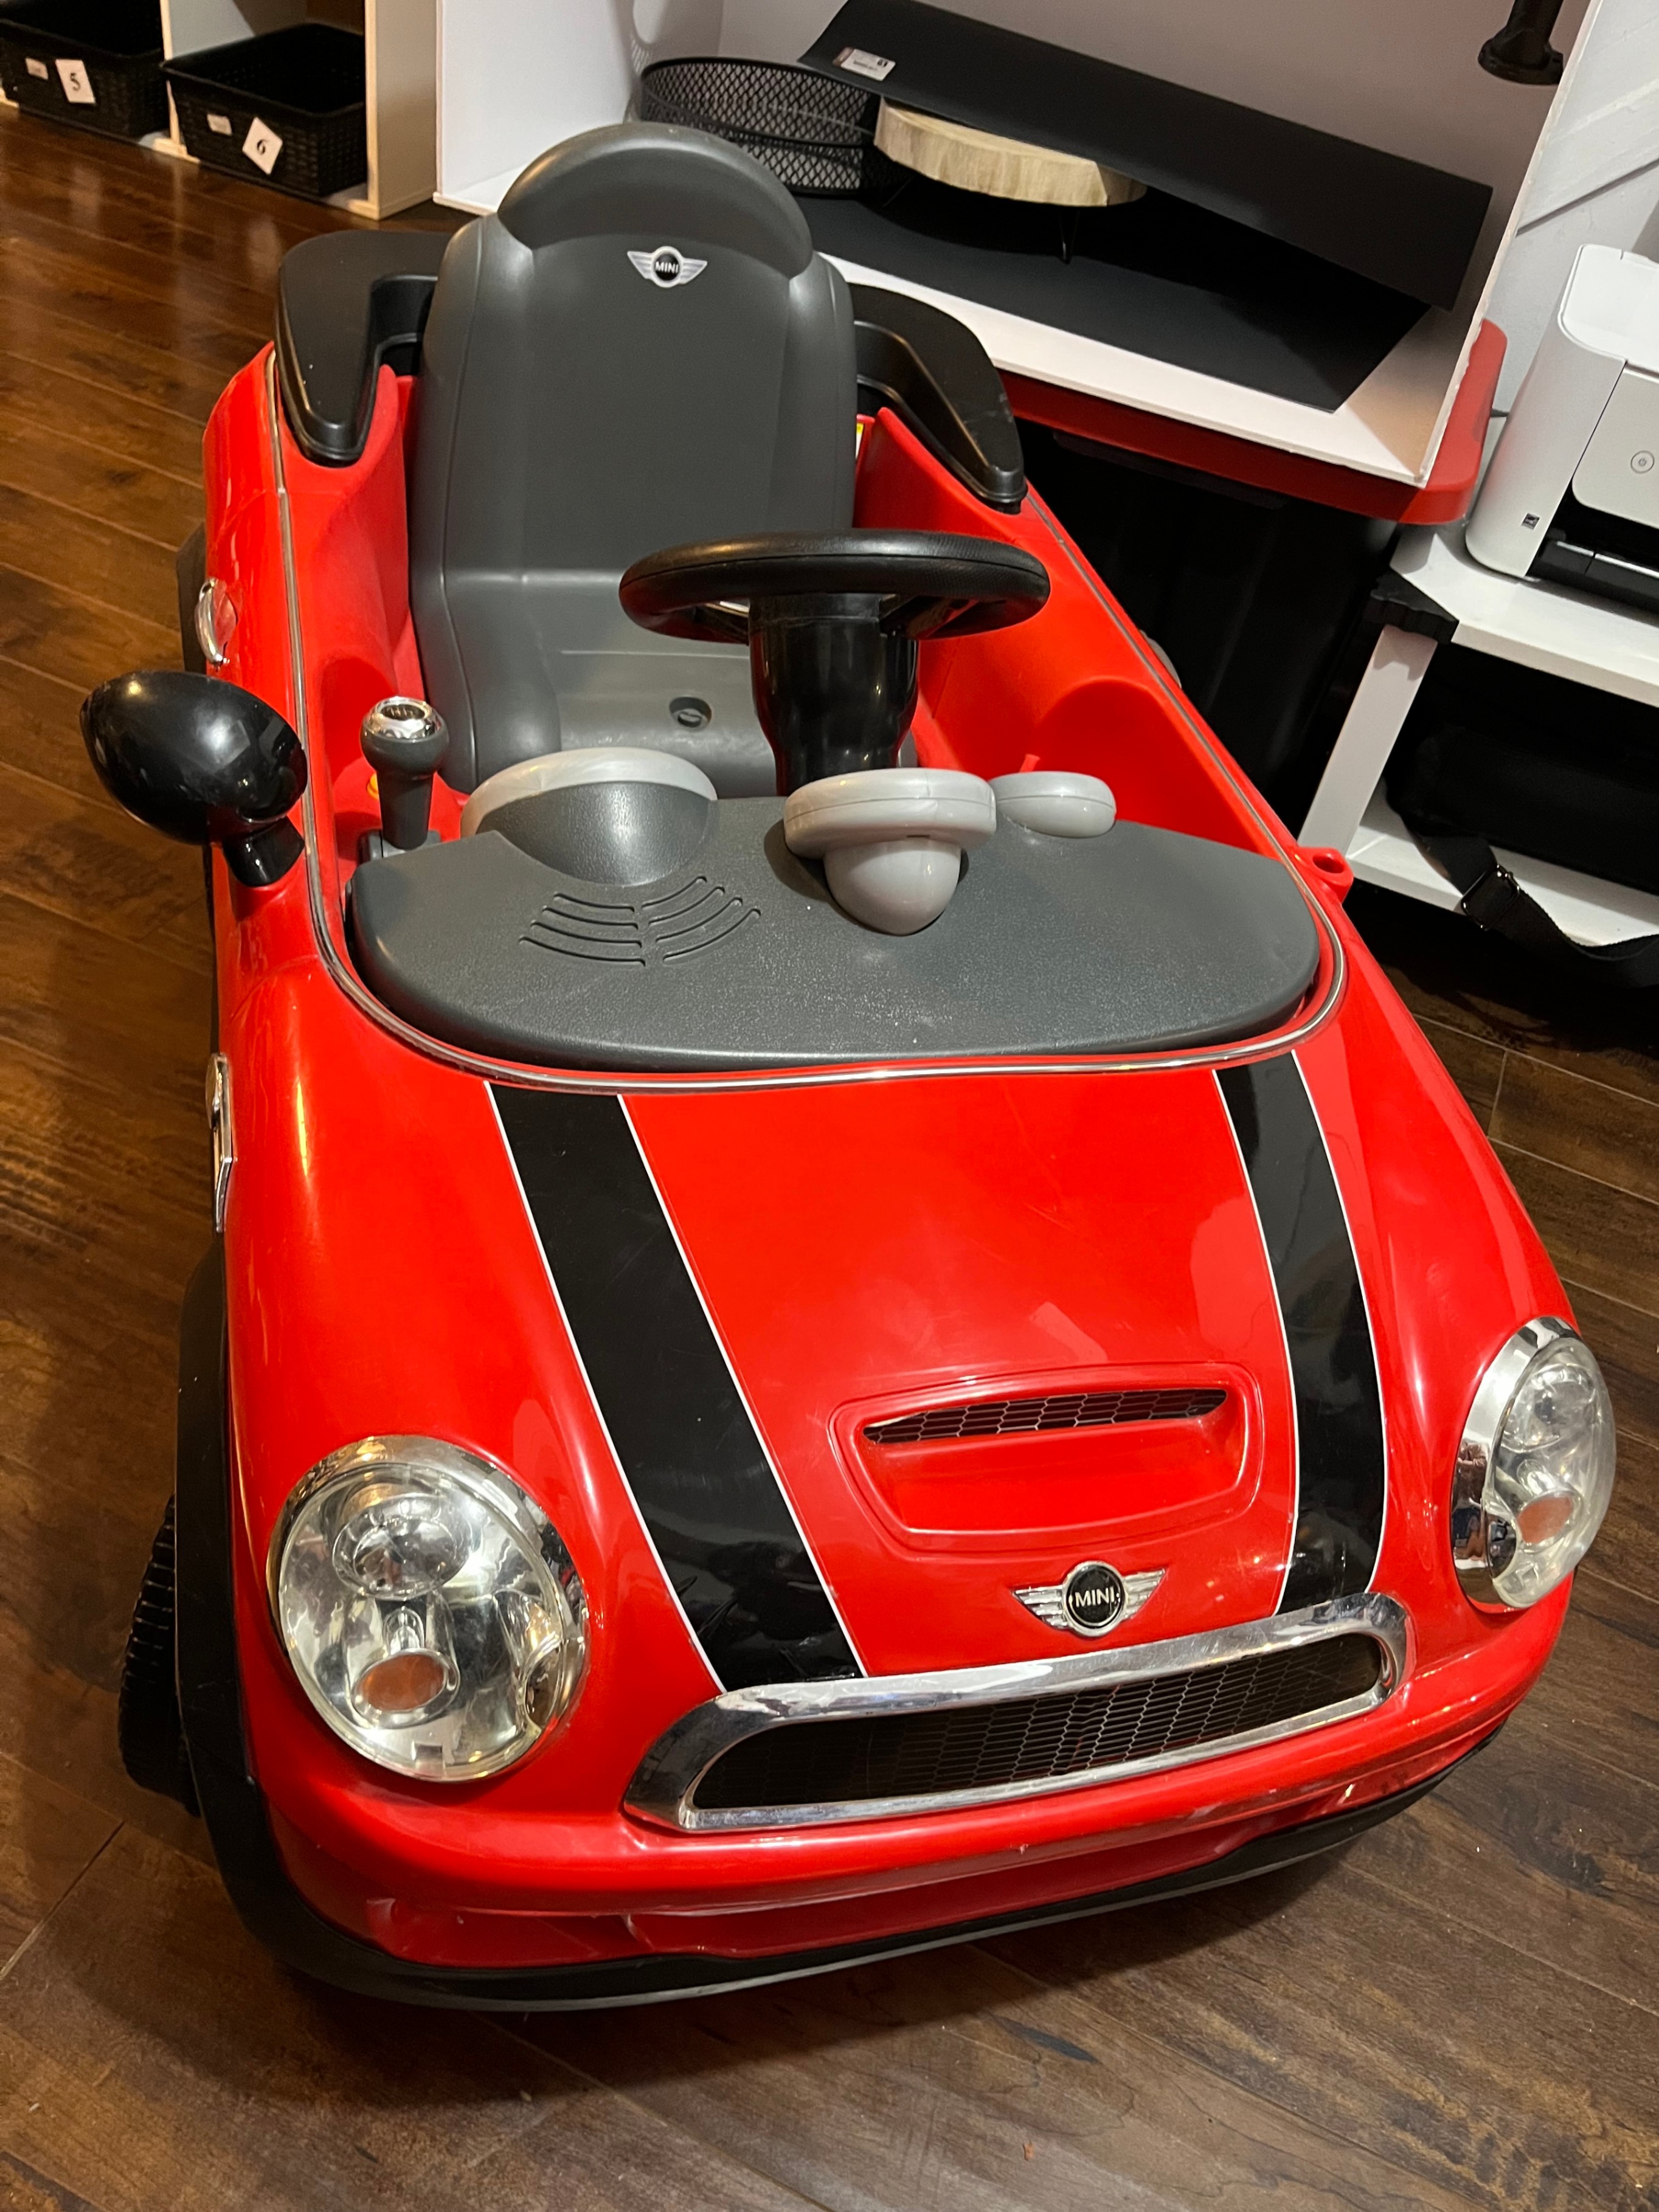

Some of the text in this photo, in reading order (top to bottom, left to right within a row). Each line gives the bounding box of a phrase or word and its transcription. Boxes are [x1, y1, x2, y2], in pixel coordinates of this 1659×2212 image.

[257, 139, 268, 155] 6
[655, 261, 679, 273] MINI
[1075, 1586, 1115, 1608] MINI
